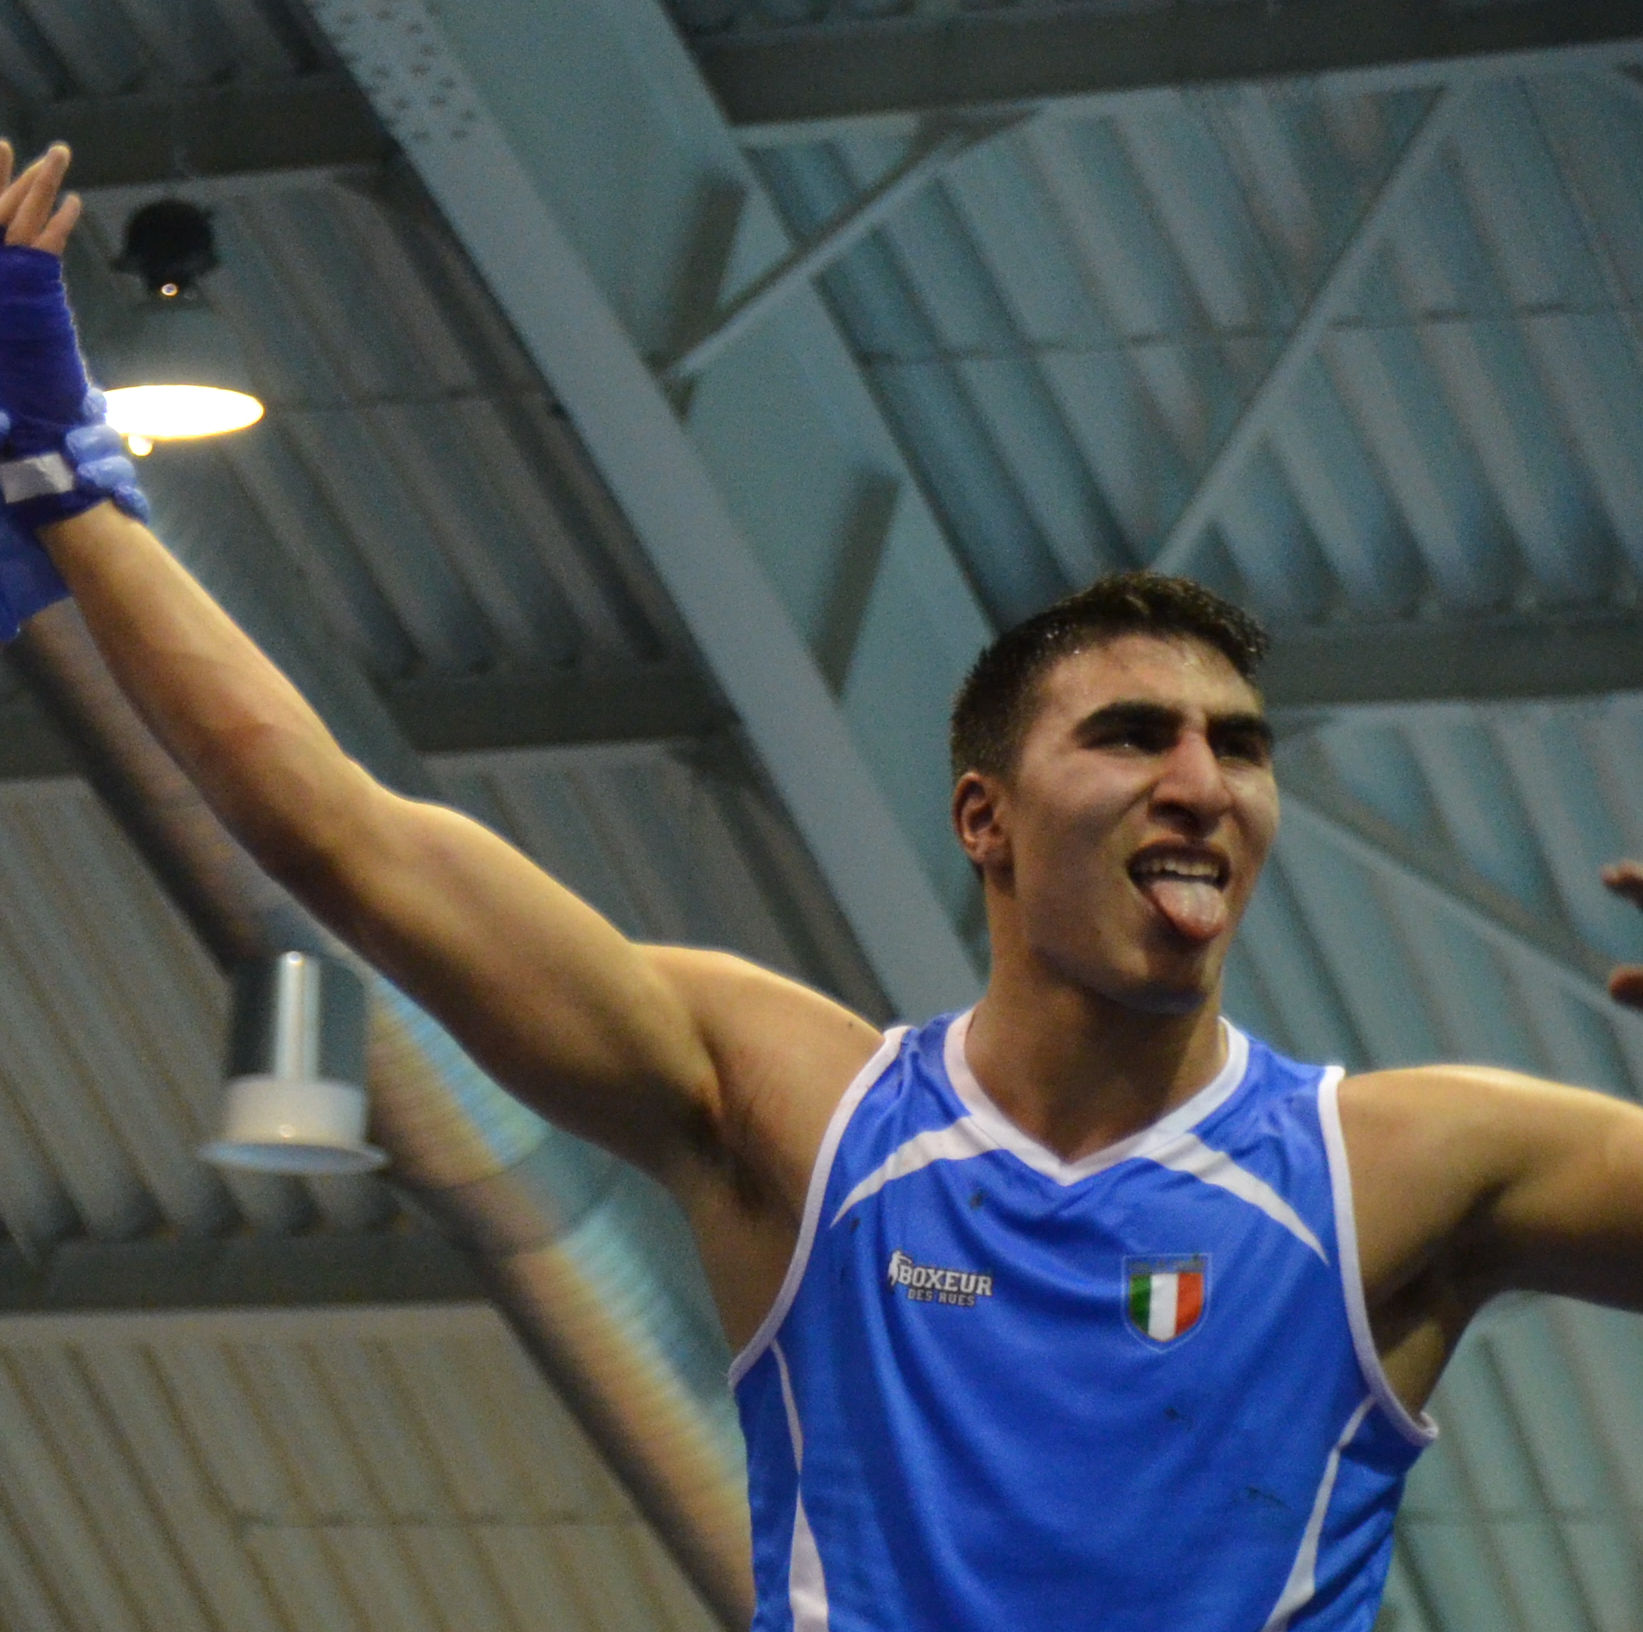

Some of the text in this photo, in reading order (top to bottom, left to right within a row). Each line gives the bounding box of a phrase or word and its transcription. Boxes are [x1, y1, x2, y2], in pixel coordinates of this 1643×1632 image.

[898, 1264, 992, 1296] BOXEUR
[908, 1289, 974, 1307] DES RUES
